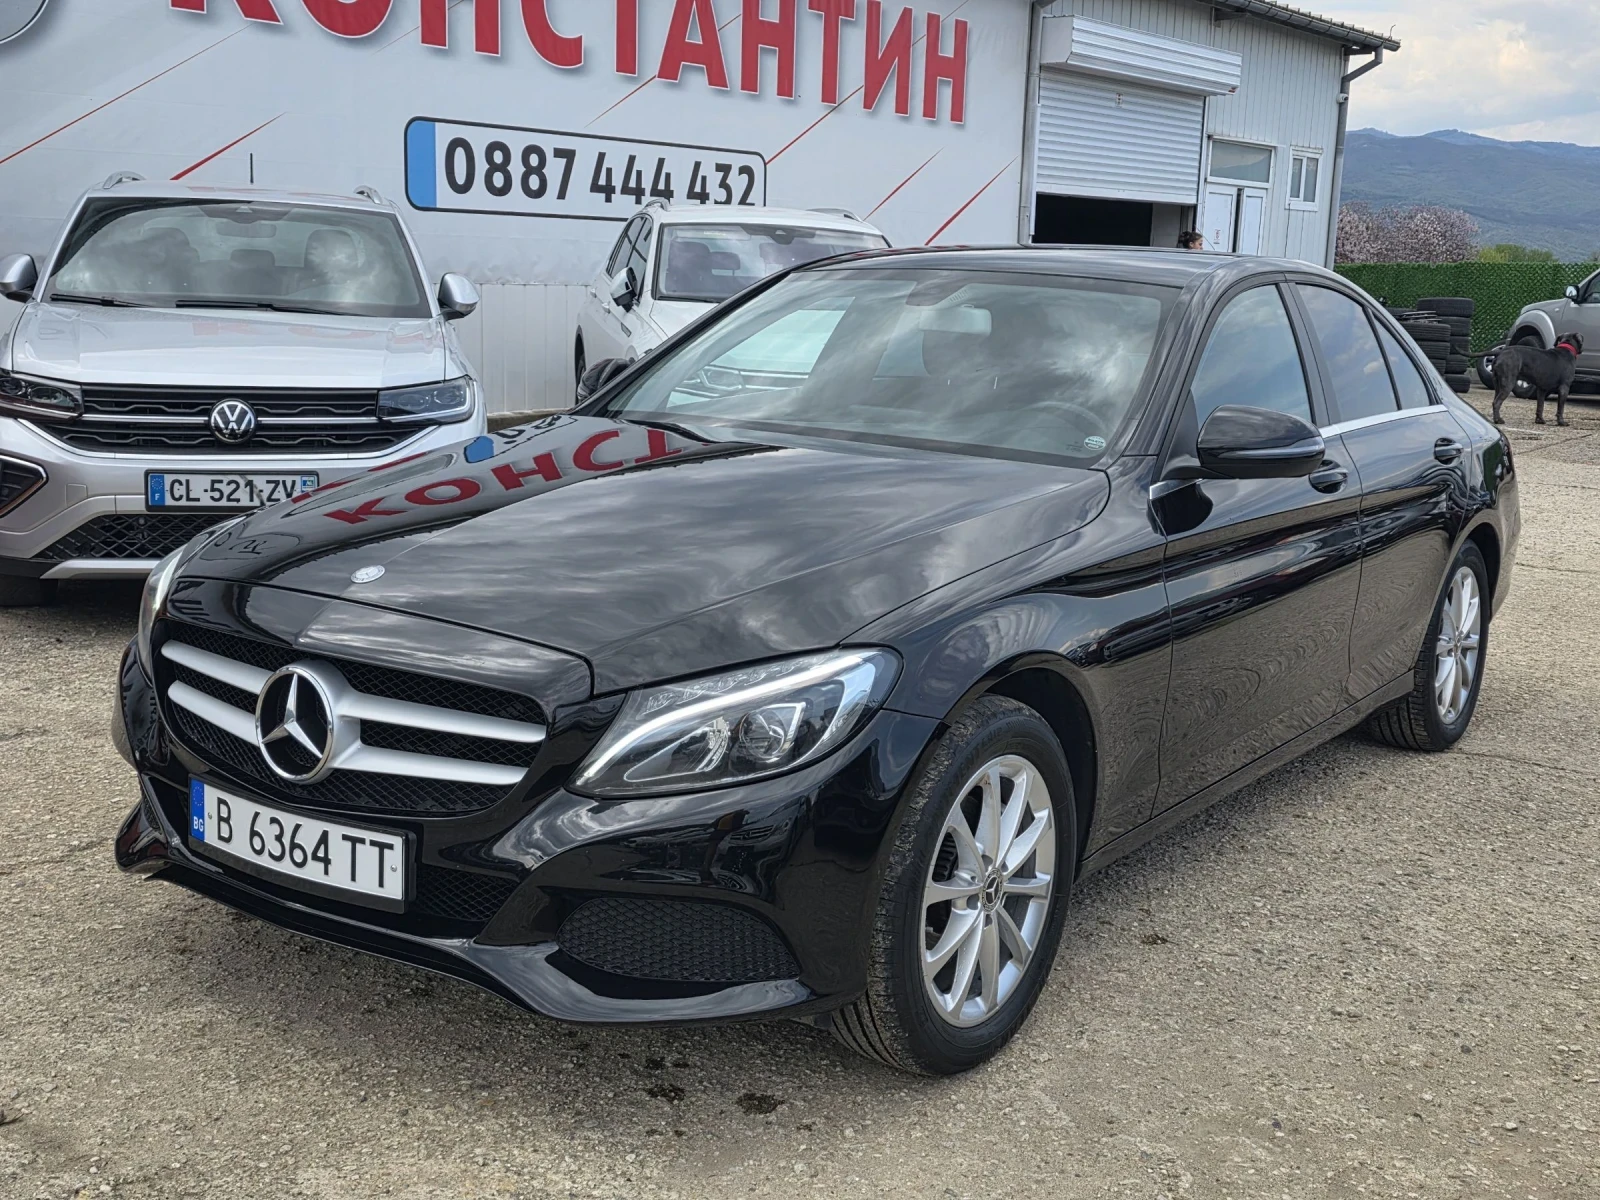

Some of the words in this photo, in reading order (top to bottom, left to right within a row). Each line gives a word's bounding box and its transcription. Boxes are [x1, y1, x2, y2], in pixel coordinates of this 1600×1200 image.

[444, 136, 577, 200] 0887
[589, 151, 674, 205] 444
[686, 160, 756, 206] 432
[155, 493, 161, 501] F
[193, 815, 204, 832] BG
[216, 796, 233, 844] B
[249, 811, 332, 876] 6364
[341, 833, 394, 888] TT
